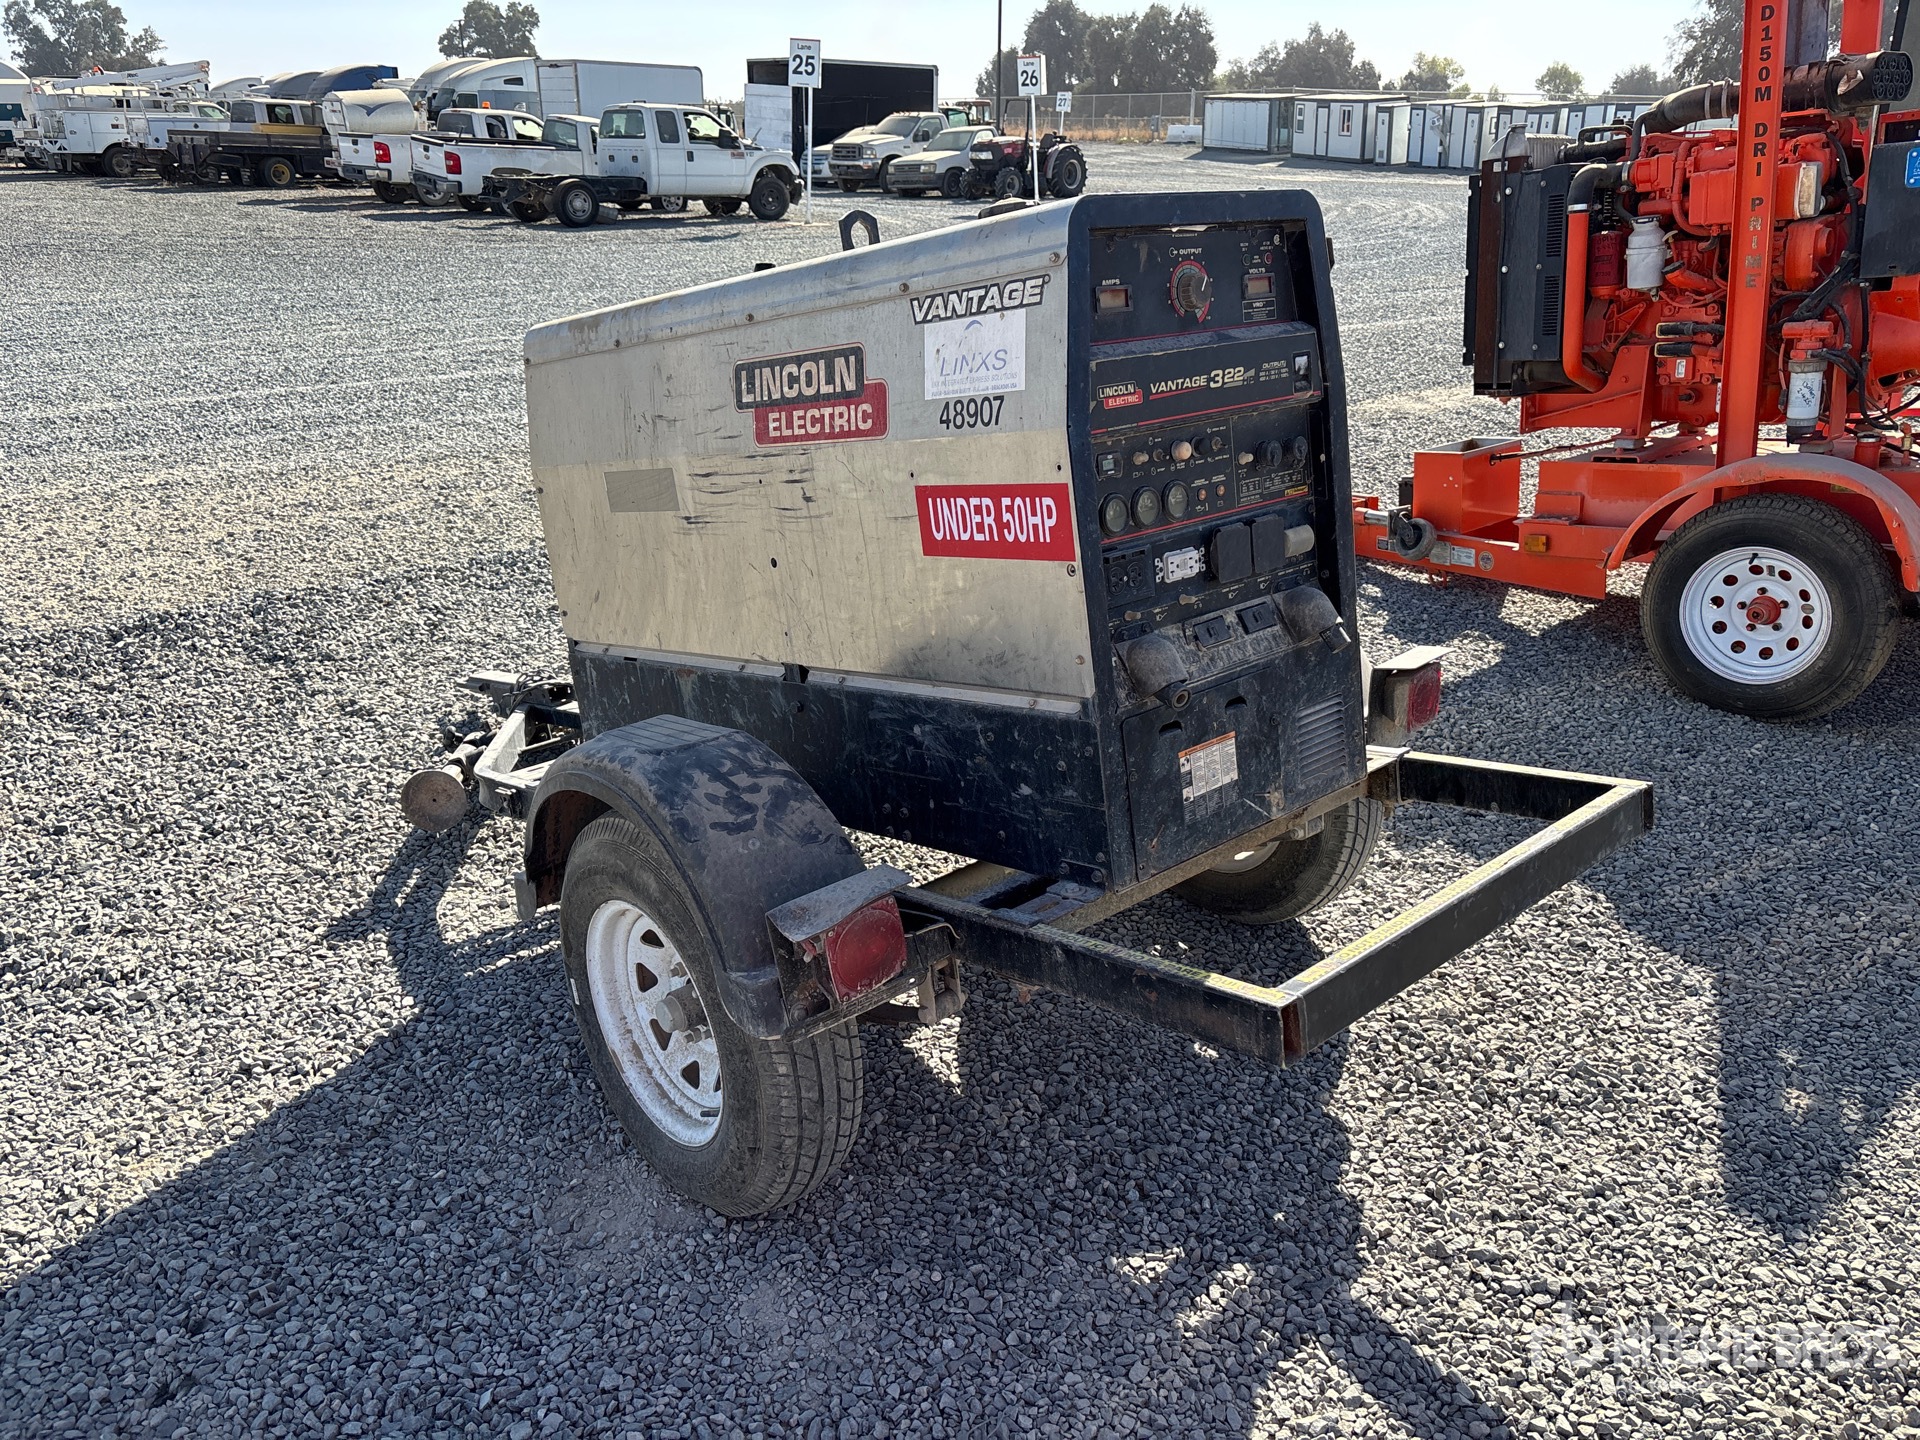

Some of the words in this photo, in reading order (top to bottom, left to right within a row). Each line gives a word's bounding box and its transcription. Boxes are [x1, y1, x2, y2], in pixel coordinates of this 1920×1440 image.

[797, 43, 812, 51] Lane
[1755, 4, 1775, 103] D150M
[792, 54, 815, 76] 25
[1020, 70, 1038, 87] 26
[1058, 98, 1067, 107] 27
[1753, 122, 1769, 177] DRI
[1744, 197, 1764, 288] PRIME
[910, 276, 1047, 324] VANTAGE
[940, 349, 1008, 377] LINXS
[1262, 360, 1285, 369] OUTPUT
[740, 354, 857, 403] LINCOLN
[1099, 384, 1134, 398] LINCOLN
[1150, 375, 1208, 394] VANTAGE
[1210, 366, 1244, 388] 322
[939, 397, 1005, 431] 48907
[1108, 395, 1139, 406] ELECTRIC
[768, 403, 873, 438] ELECTRIC
[927, 496, 999, 542] UNDER
[1001, 496, 1057, 543] 50HP
